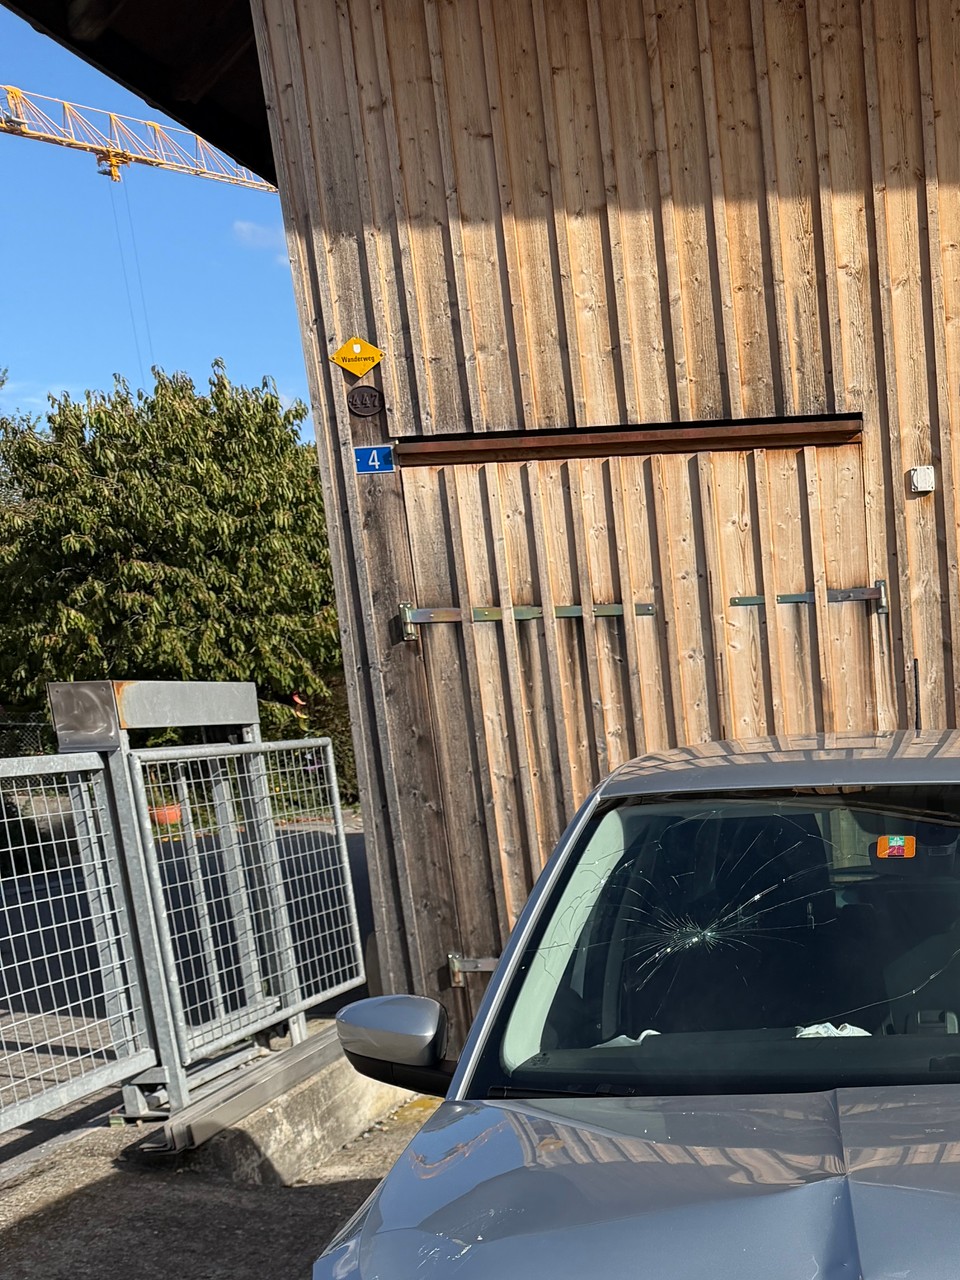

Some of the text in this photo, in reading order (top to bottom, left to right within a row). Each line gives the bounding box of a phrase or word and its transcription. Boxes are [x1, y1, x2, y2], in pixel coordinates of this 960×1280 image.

[341, 355, 375, 363] Wanderweg
[351, 392, 379, 409] 447
[368, 449, 381, 470] 4
